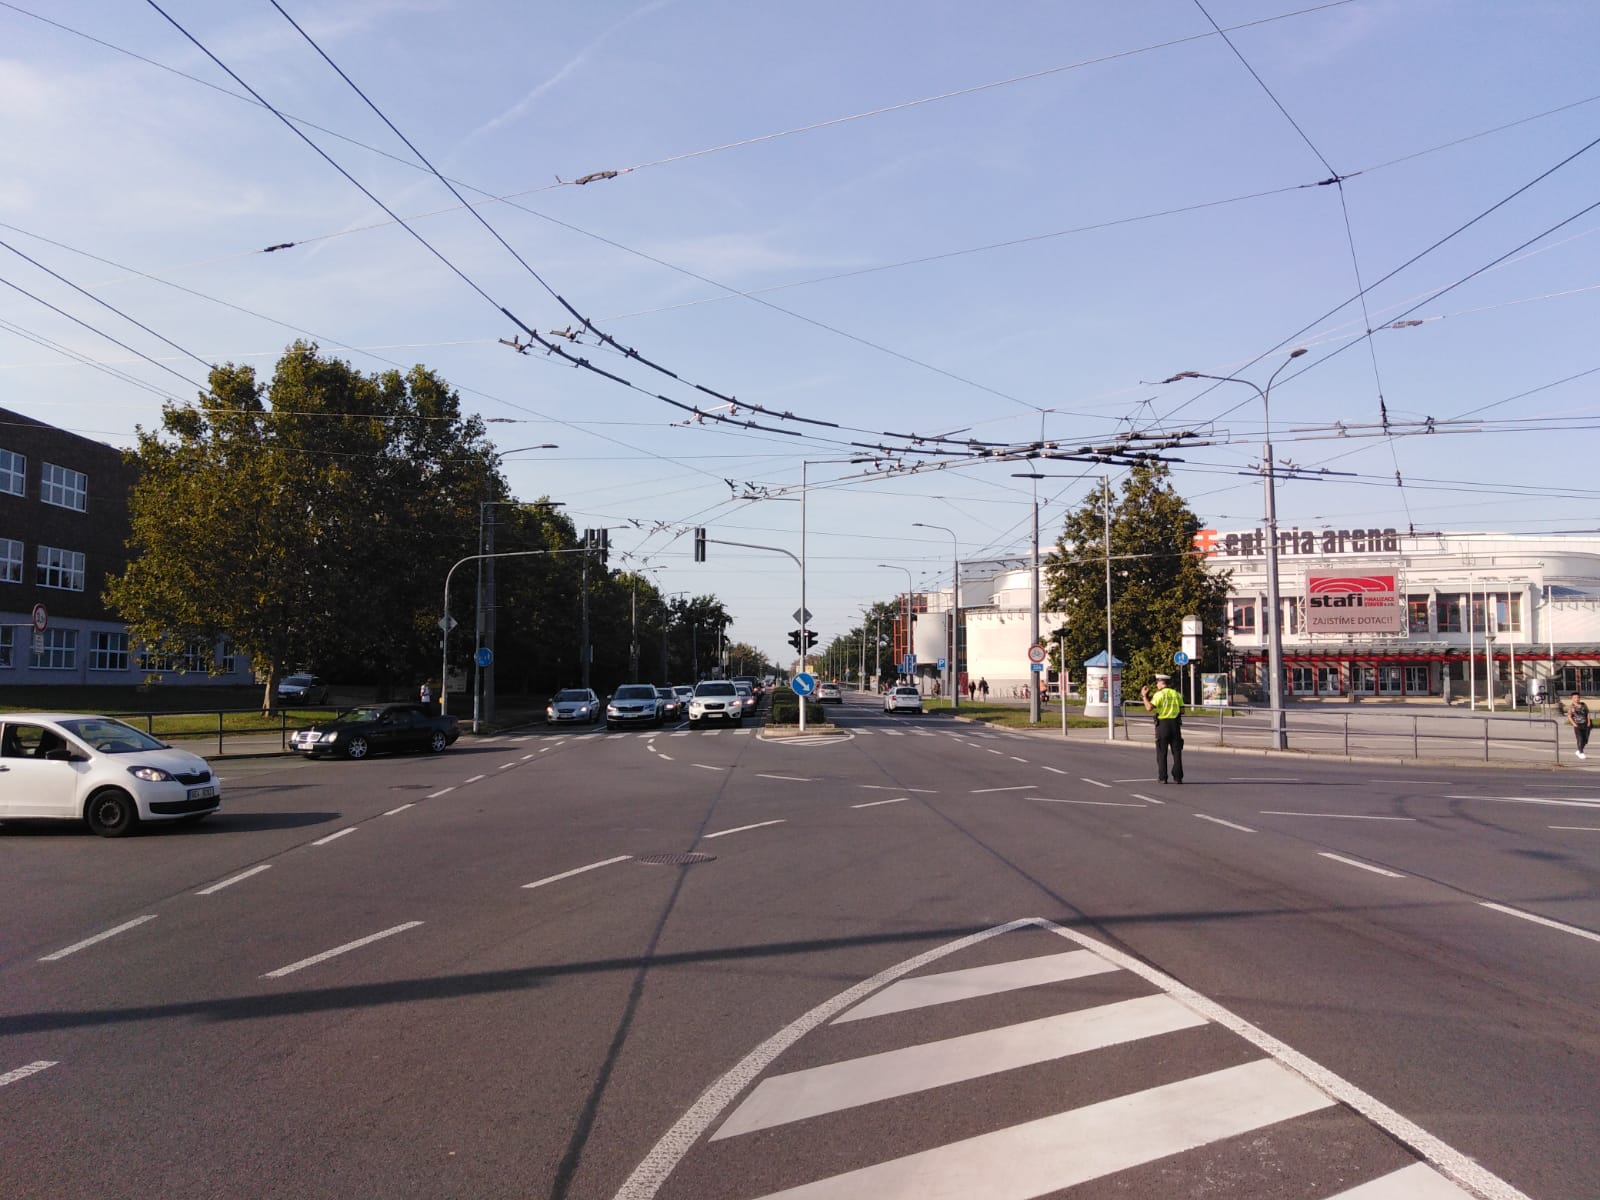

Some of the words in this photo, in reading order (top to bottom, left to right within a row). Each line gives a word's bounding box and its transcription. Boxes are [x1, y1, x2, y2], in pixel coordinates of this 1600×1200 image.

[1226, 527, 1314, 556] entria
[1323, 528, 1397, 553] arena
[1310, 593, 1362, 608] stafi
[1312, 615, 1356, 625] ZAJISTÍME
